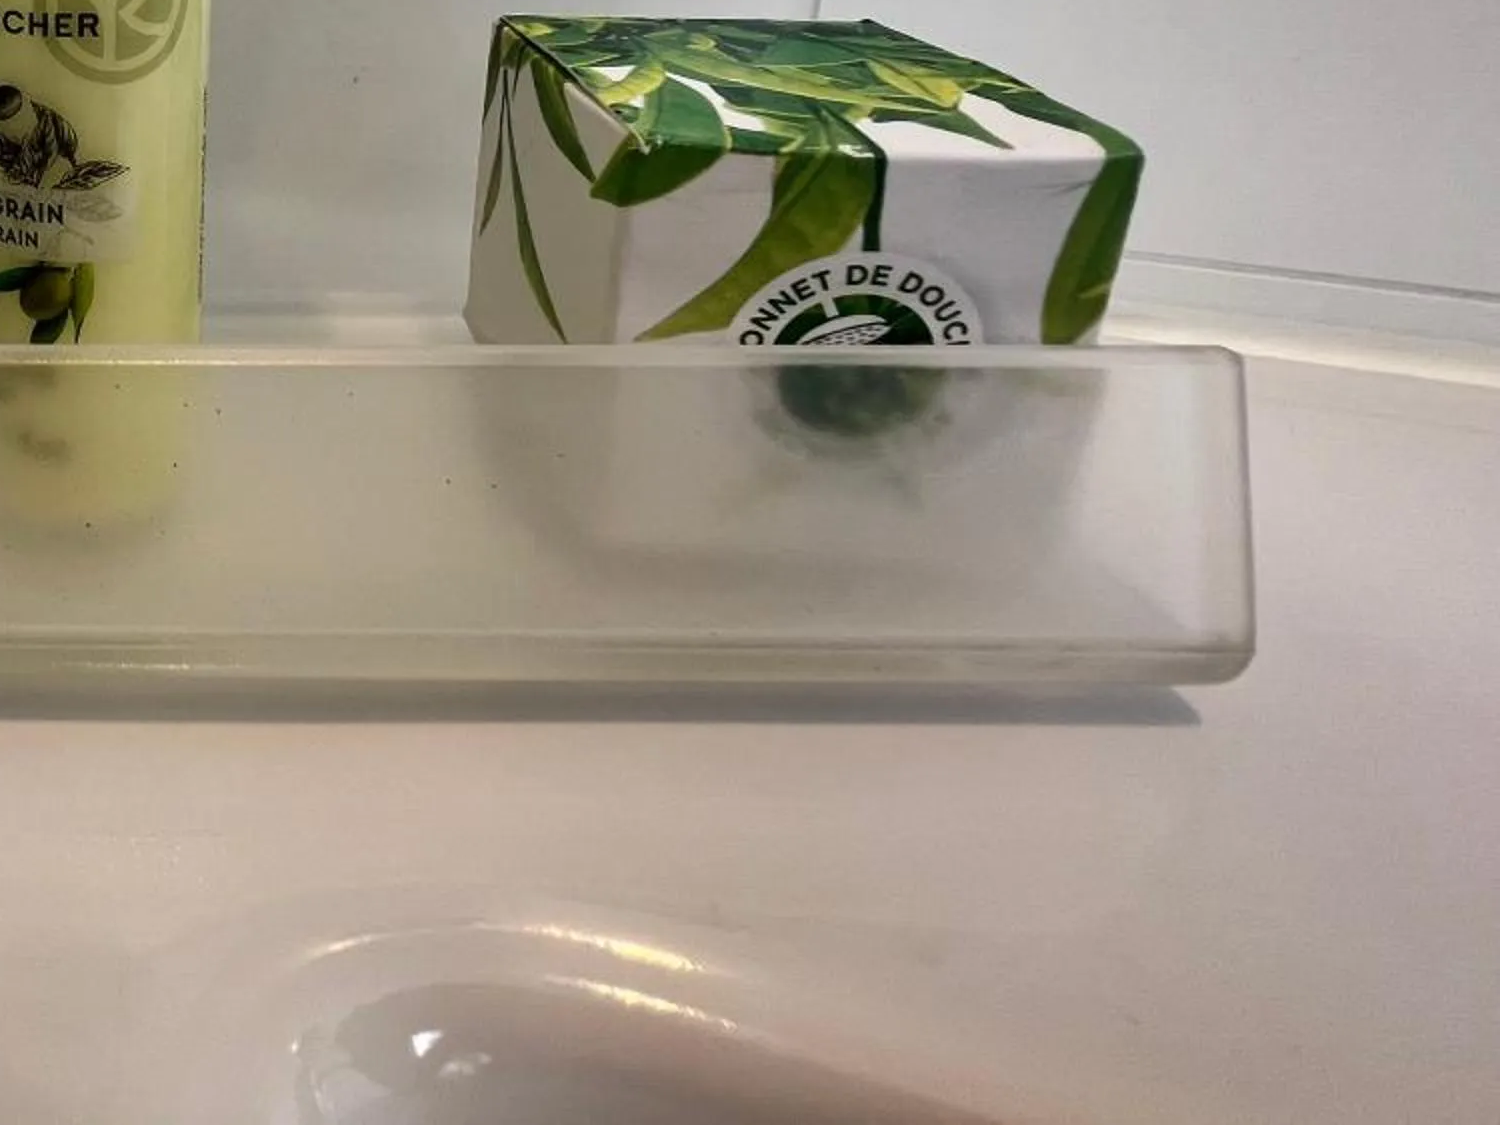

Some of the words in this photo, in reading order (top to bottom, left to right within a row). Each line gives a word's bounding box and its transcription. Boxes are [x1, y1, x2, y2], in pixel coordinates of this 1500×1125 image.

[739, 269, 832, 345] ONNET
[845, 264, 893, 287] DE
[896, 271, 971, 345] DOUC
